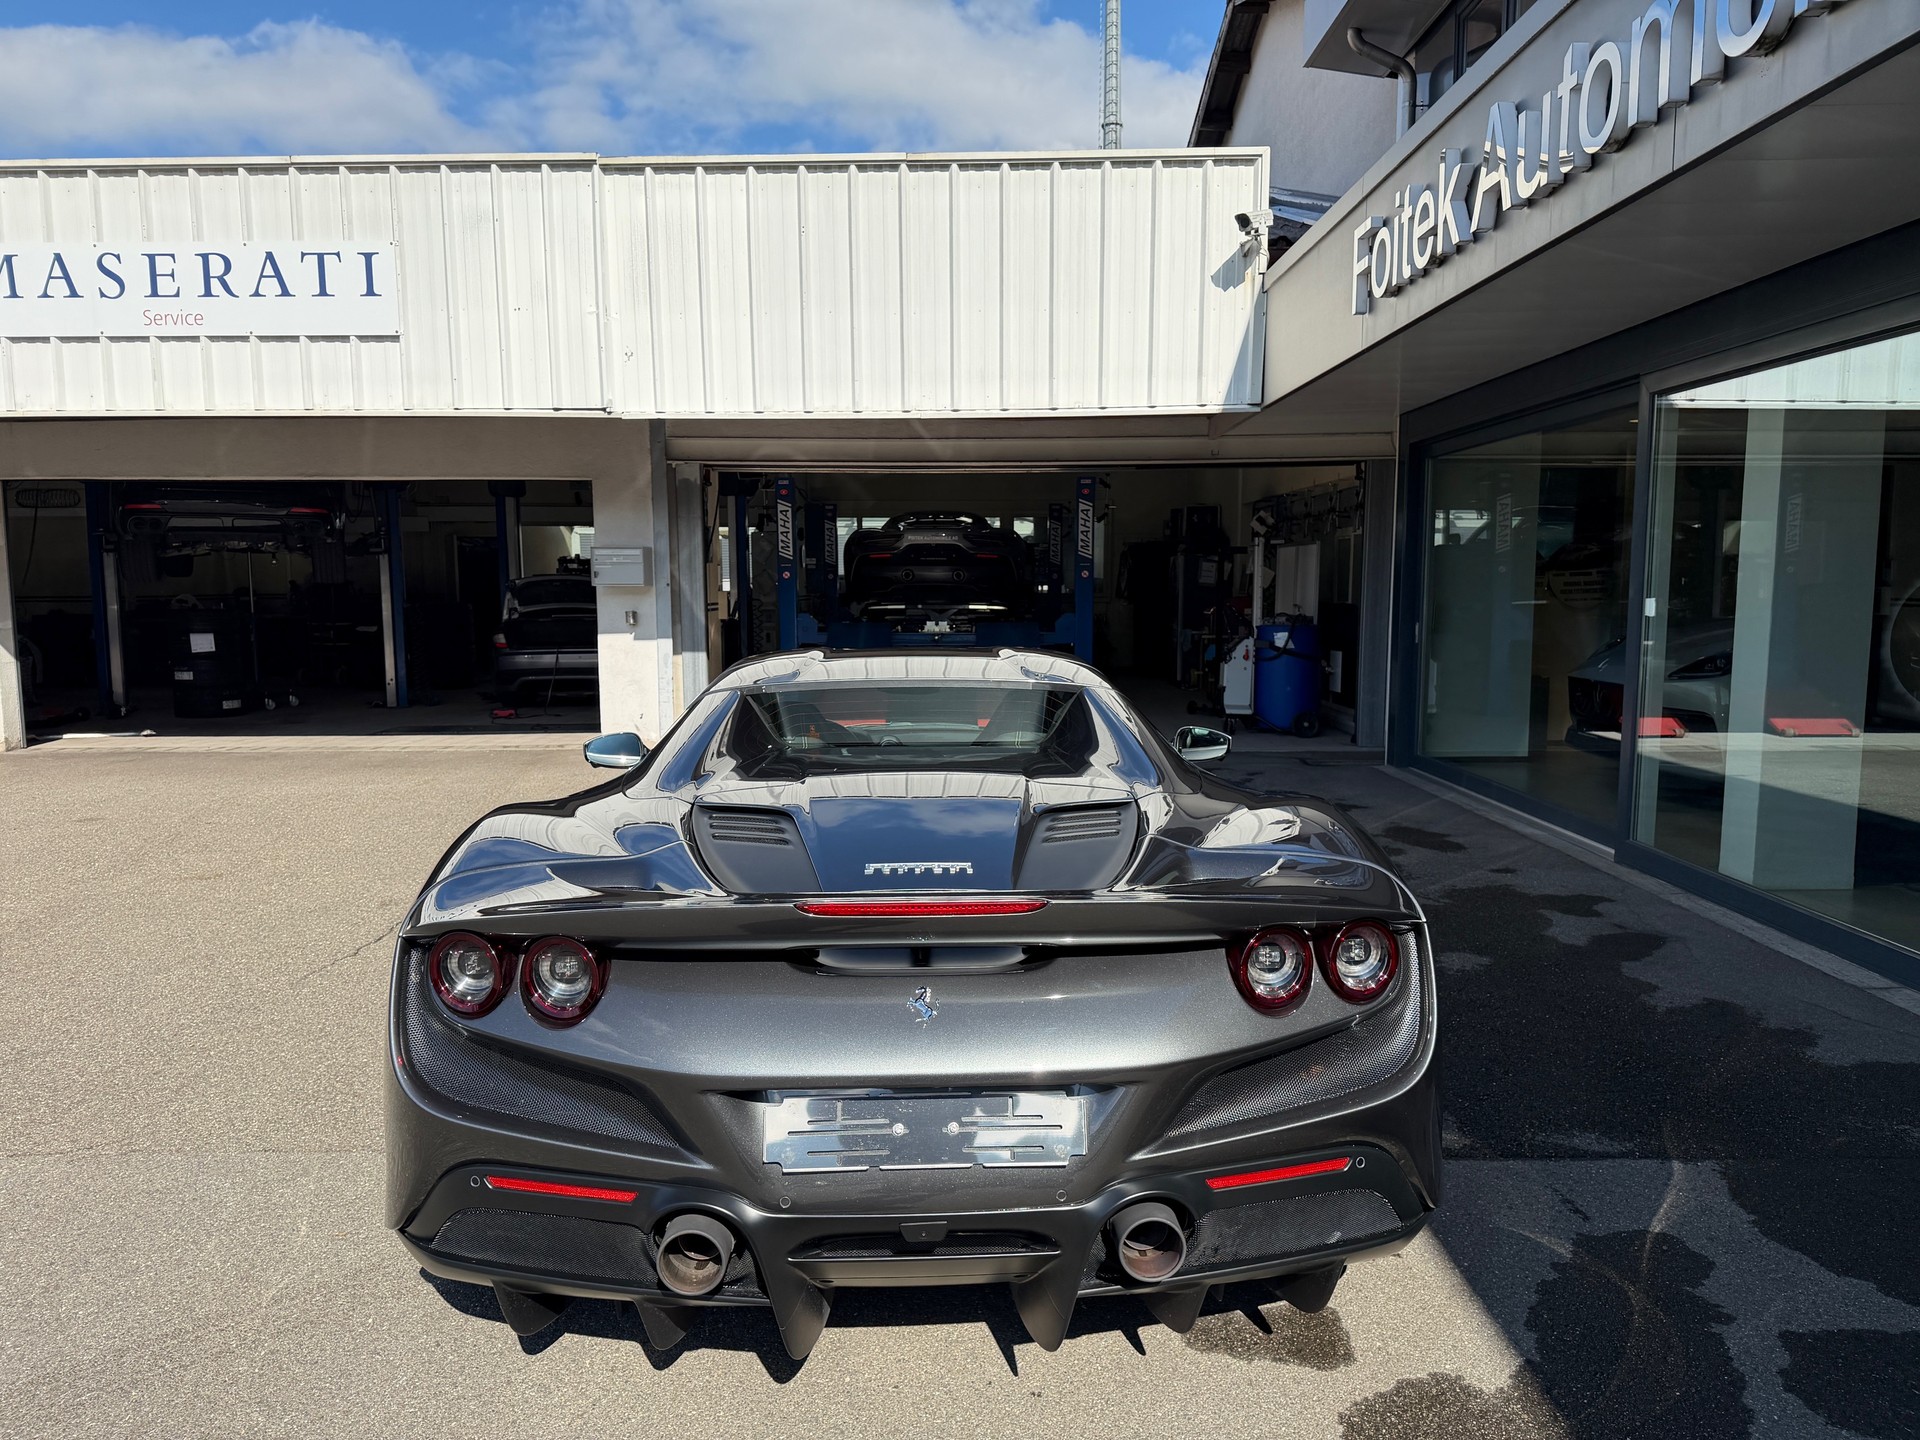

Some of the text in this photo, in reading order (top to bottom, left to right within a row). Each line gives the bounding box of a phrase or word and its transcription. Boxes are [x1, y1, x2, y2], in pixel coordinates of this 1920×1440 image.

[1352, 0, 1808, 316] Foitek Autom
[142, 308, 204, 326] Service
[780, 508, 791, 552] MAHA
[825, 526, 836, 561] MAHA
[1051, 526, 1060, 560] MAHA
[1080, 508, 1091, 552] MAHA
